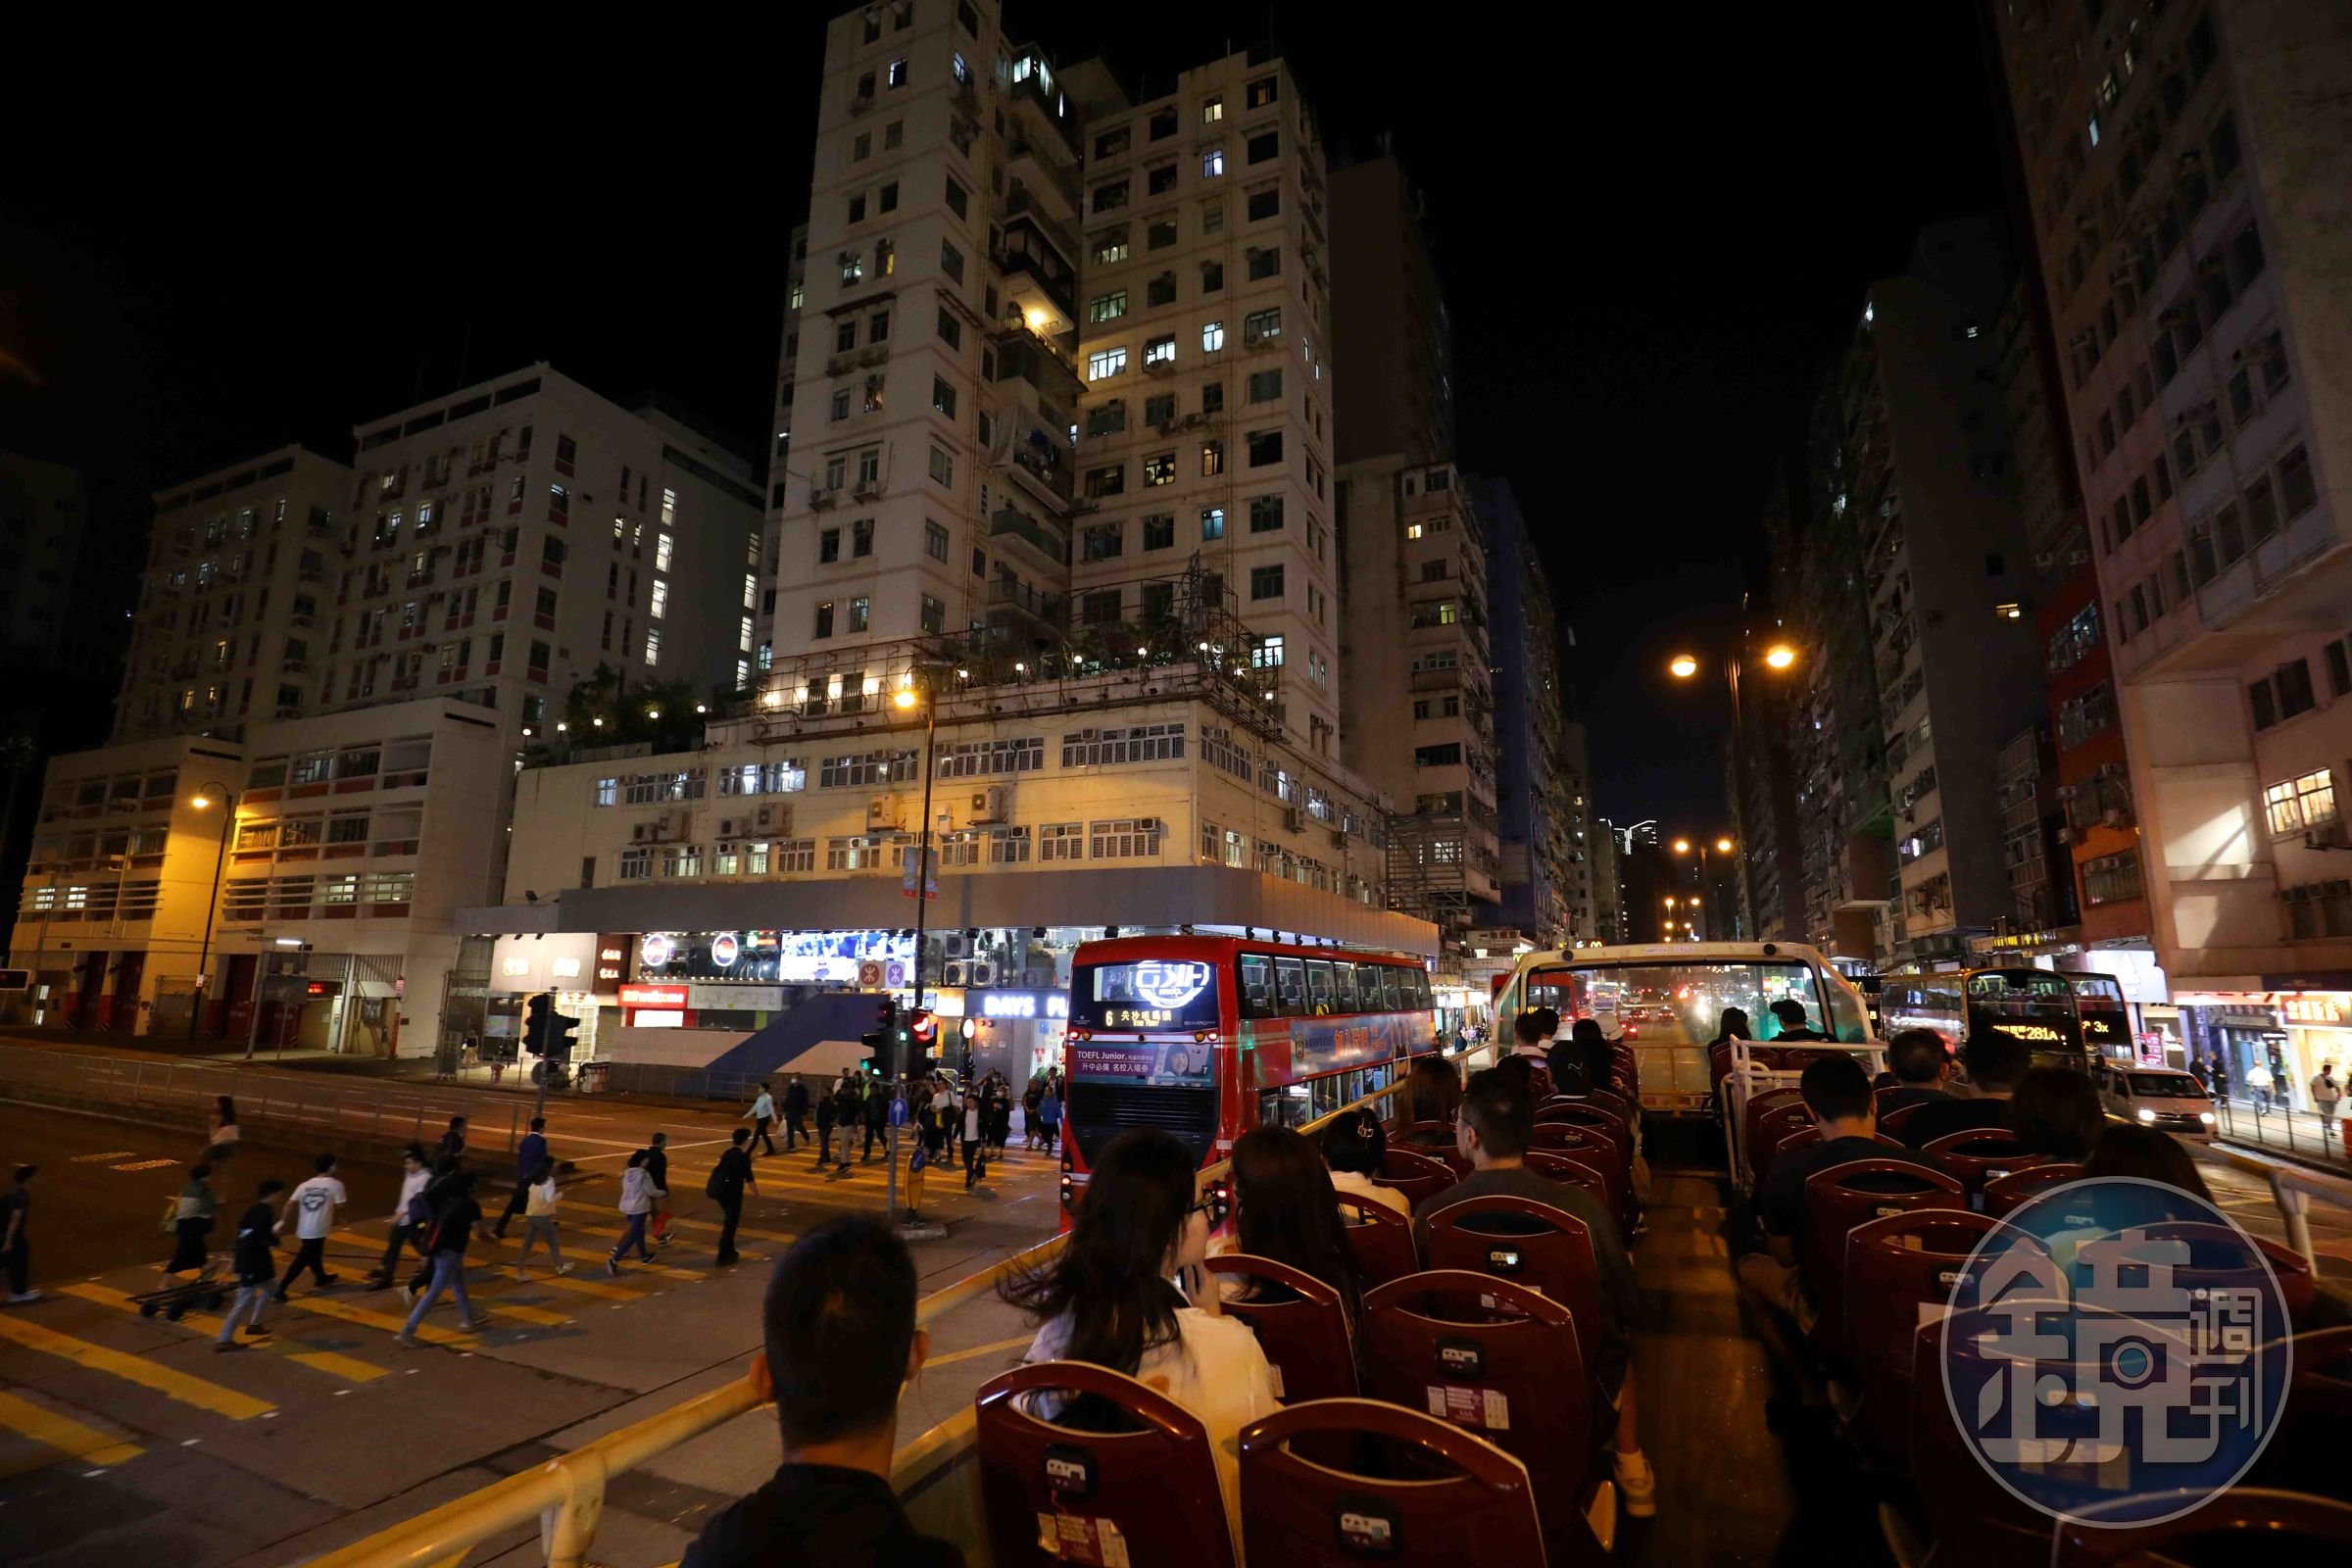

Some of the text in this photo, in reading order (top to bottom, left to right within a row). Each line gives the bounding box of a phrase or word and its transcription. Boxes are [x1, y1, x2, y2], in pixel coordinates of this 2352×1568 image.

[984, 996, 1035, 1017] DAYS
[1105, 1010, 1113, 1026] 6
[2026, 1026, 2059, 1041] 281A
[1077, 1051, 1101, 1059] TOEFL
